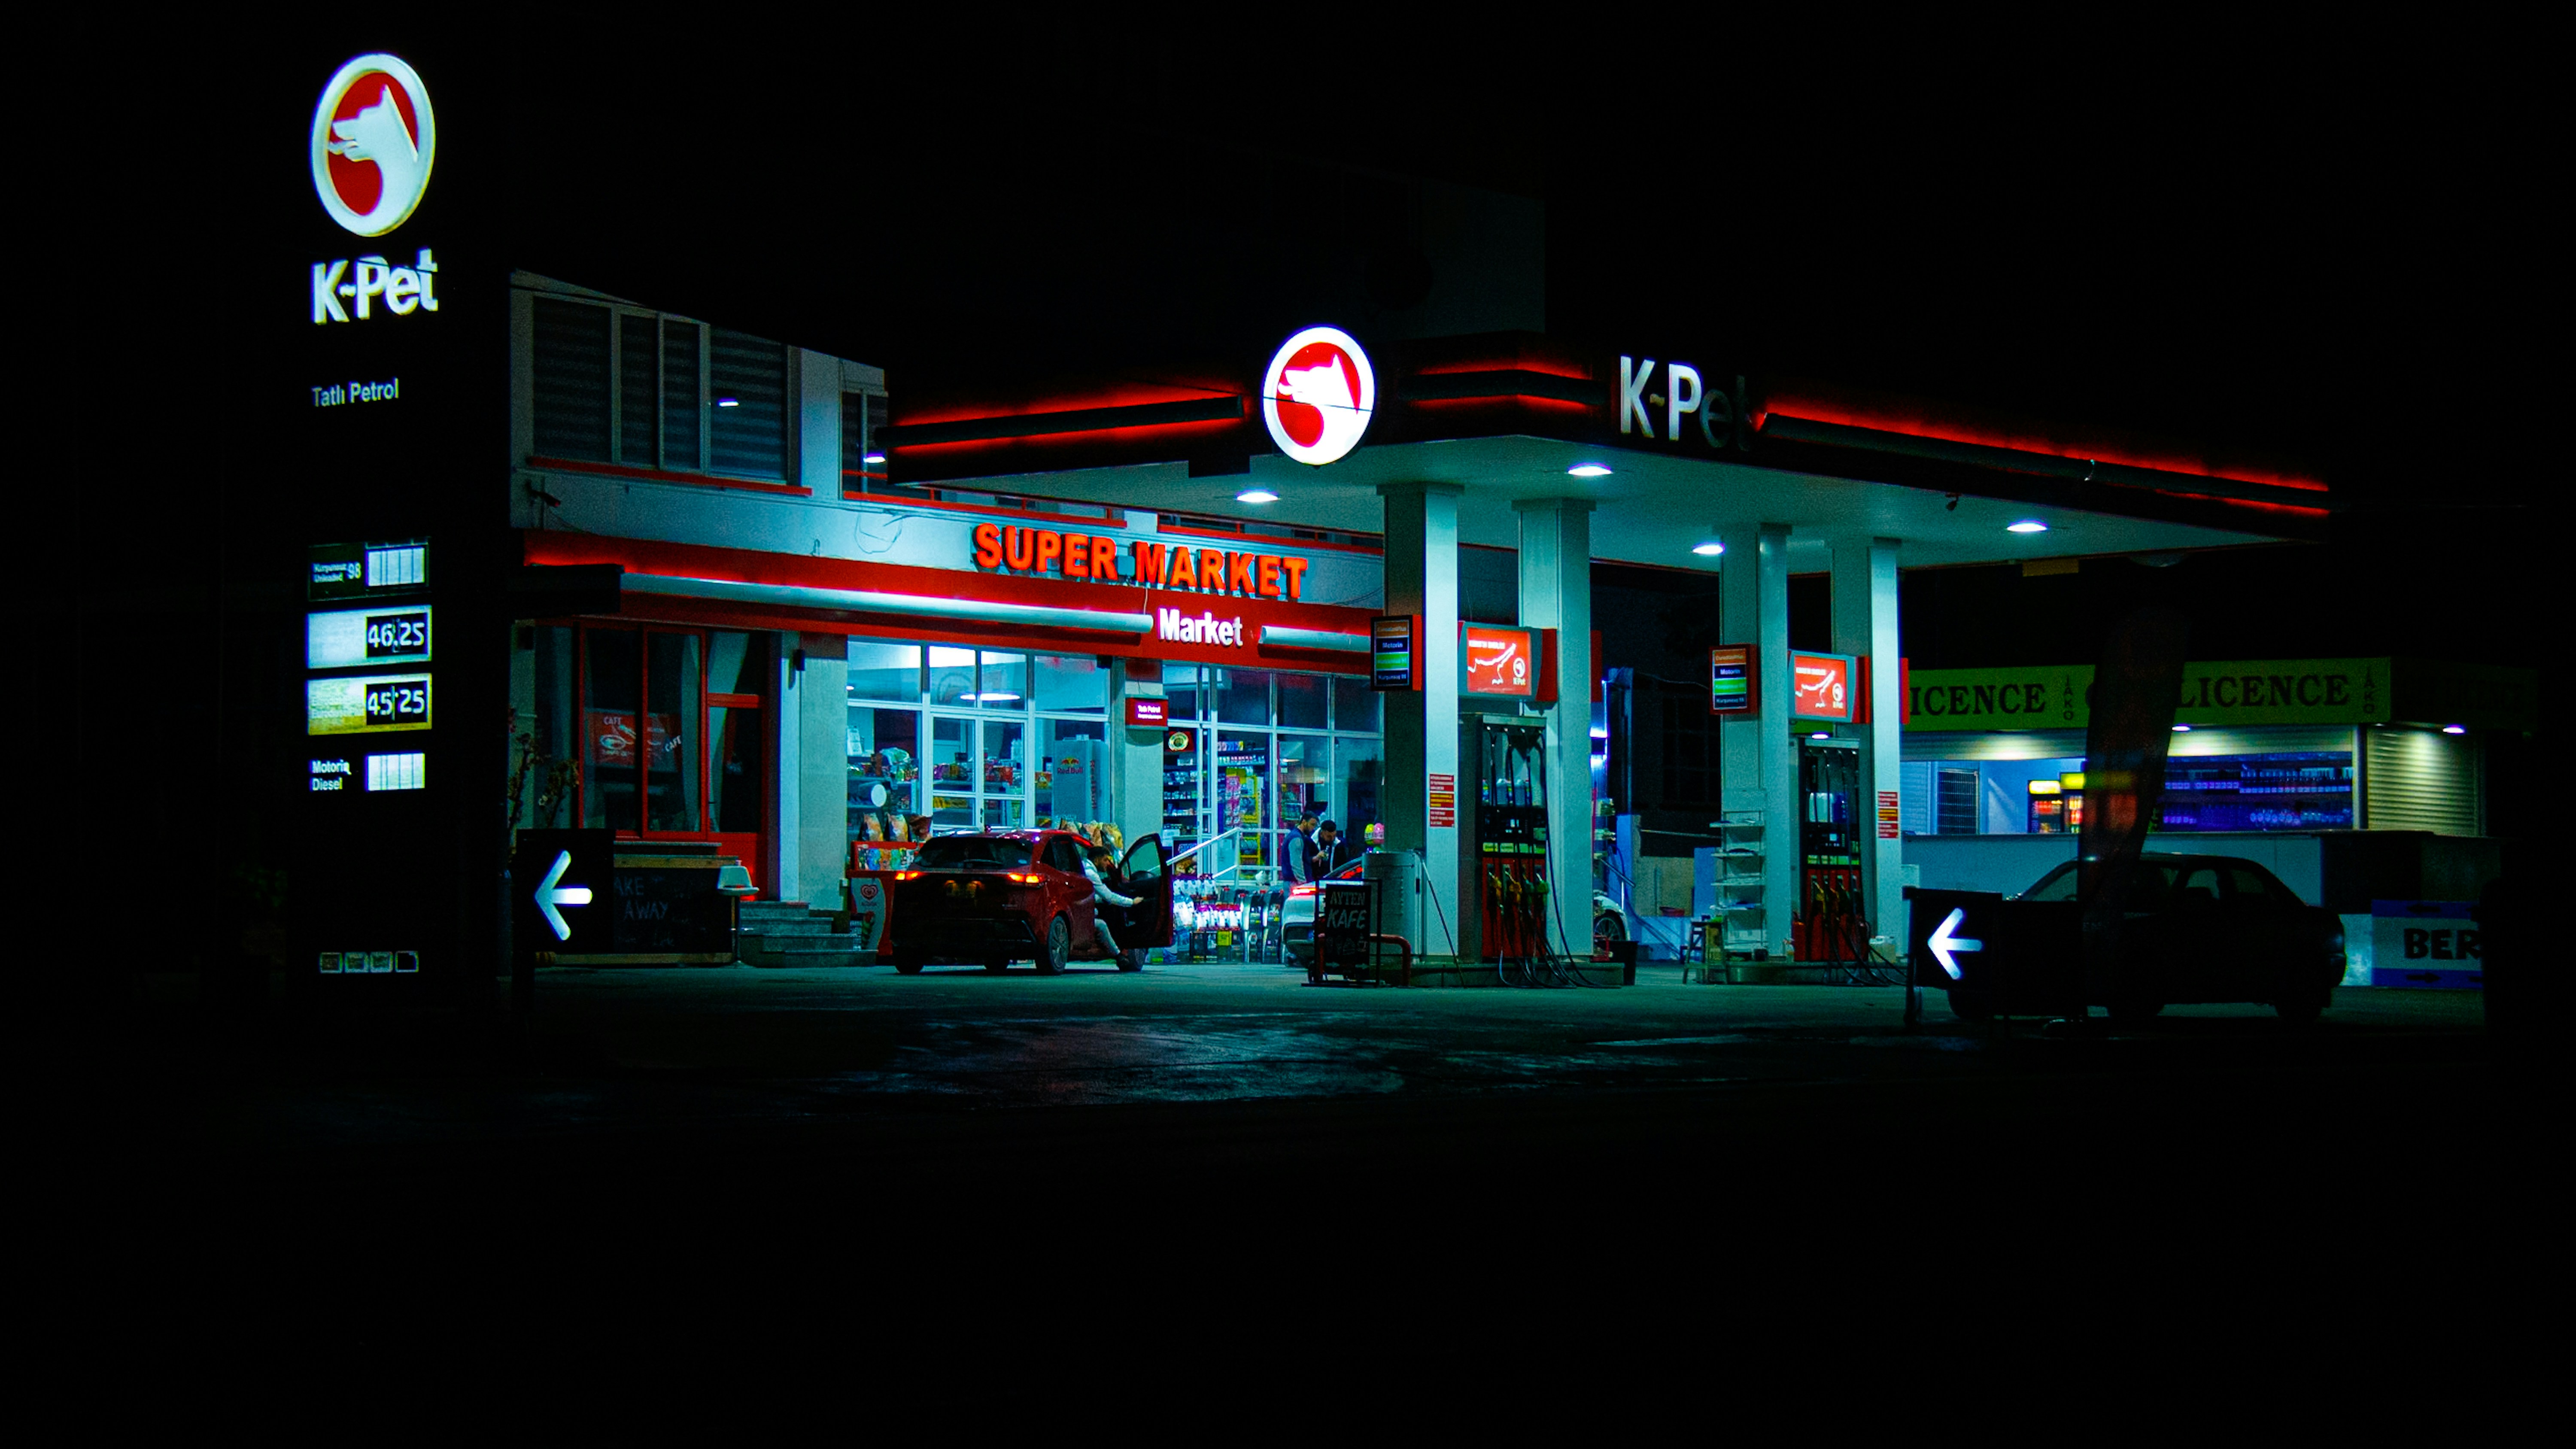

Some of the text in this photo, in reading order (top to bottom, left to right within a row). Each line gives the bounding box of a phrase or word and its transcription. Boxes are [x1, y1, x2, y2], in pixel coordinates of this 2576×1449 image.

[311, 248, 438, 325] K-Pet
[349, 377, 399, 402] Petrol
[976, 522, 1308, 599] SUPER MARKET
[1158, 608, 1243, 647] Market
[312, 776, 343, 791] Diesel
